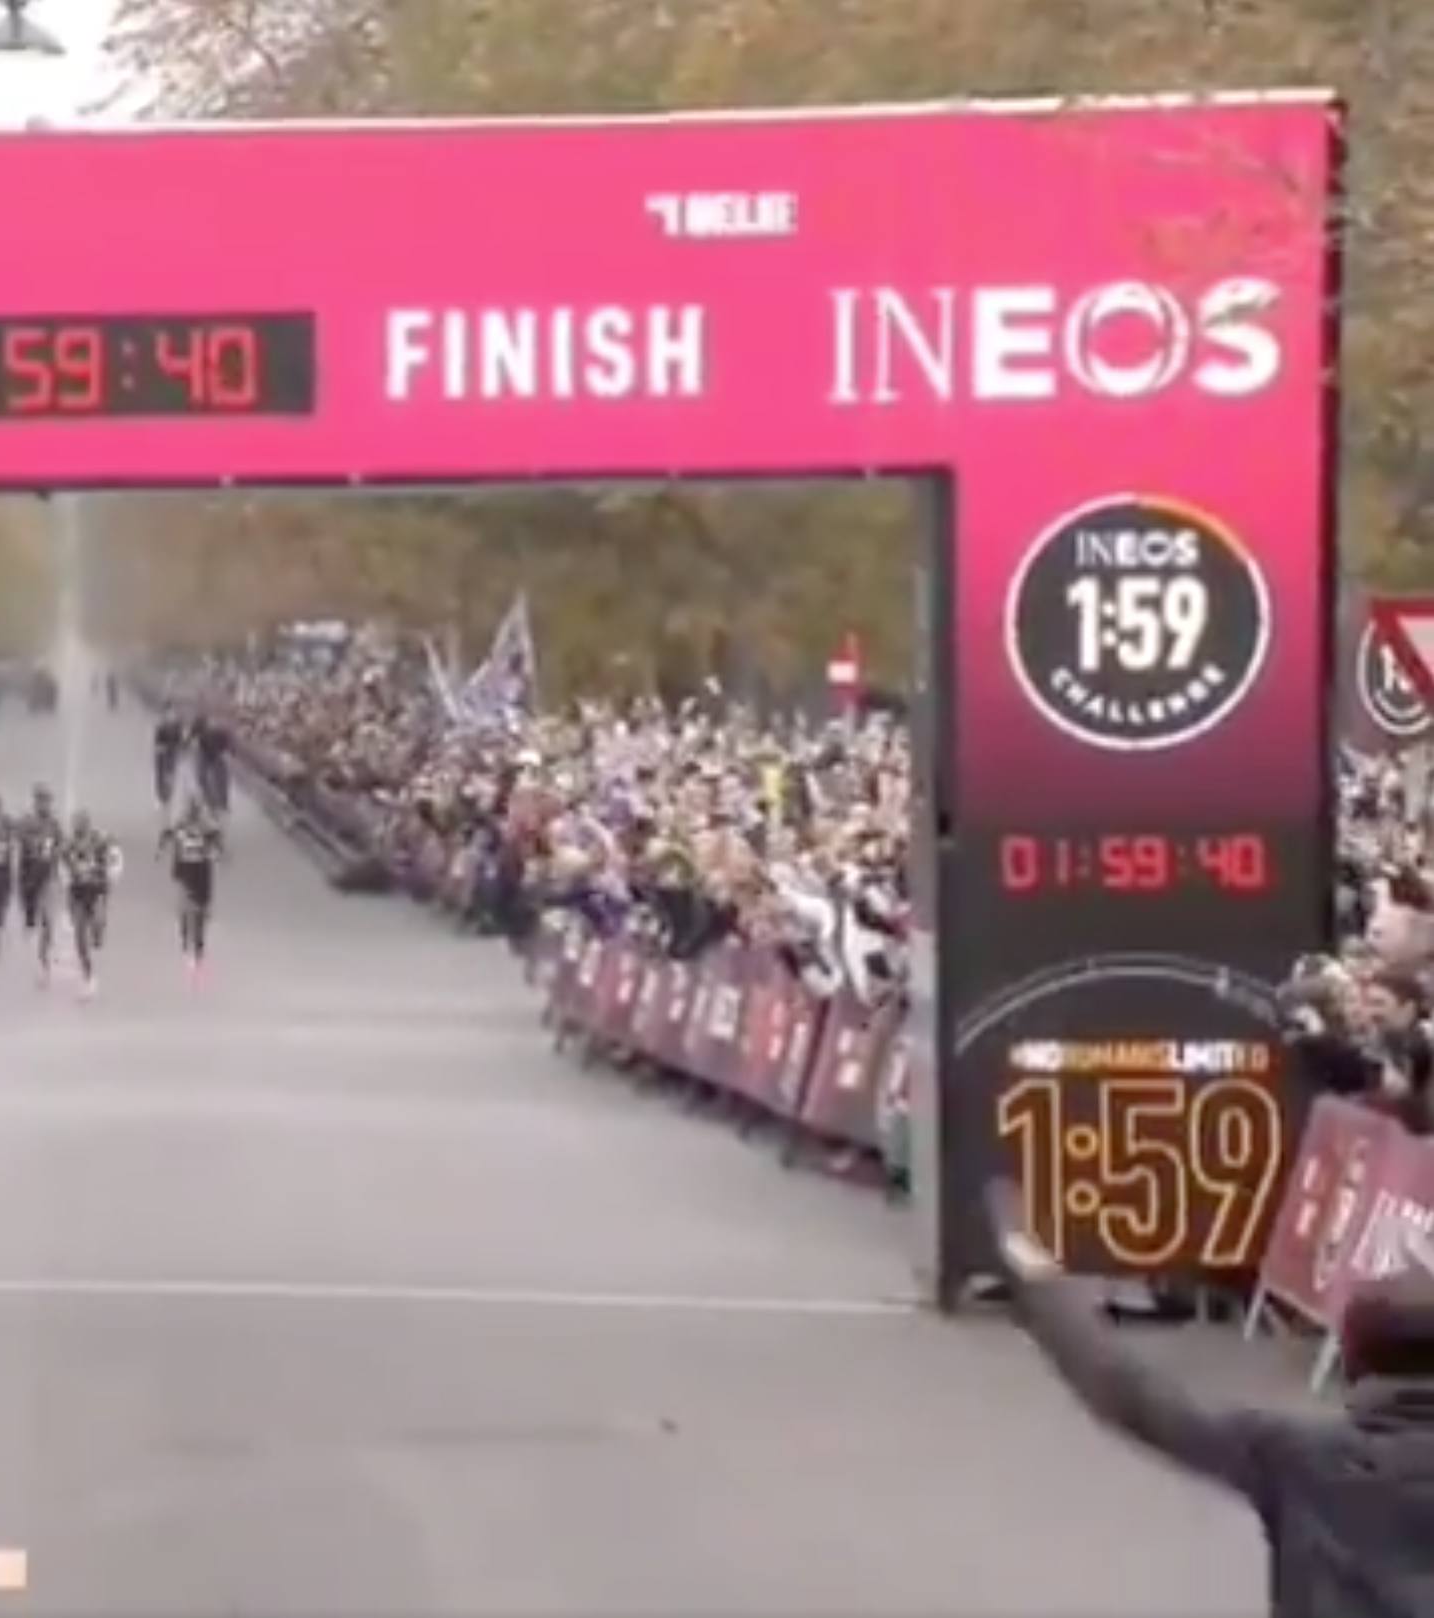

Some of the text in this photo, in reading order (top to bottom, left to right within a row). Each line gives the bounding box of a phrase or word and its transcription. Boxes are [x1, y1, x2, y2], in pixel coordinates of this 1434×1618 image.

[385, 304, 705, 400] FINISH
[828, 277, 1281, 404] INEOS
[1074, 527, 1202, 569] INEOS
[1066, 574, 1211, 672] 1:59
[1051, 662, 1226, 724] CHALLENGE
[1000, 835, 1267, 890] 01:59:40
[996, 1077, 1281, 1266] 1:59
